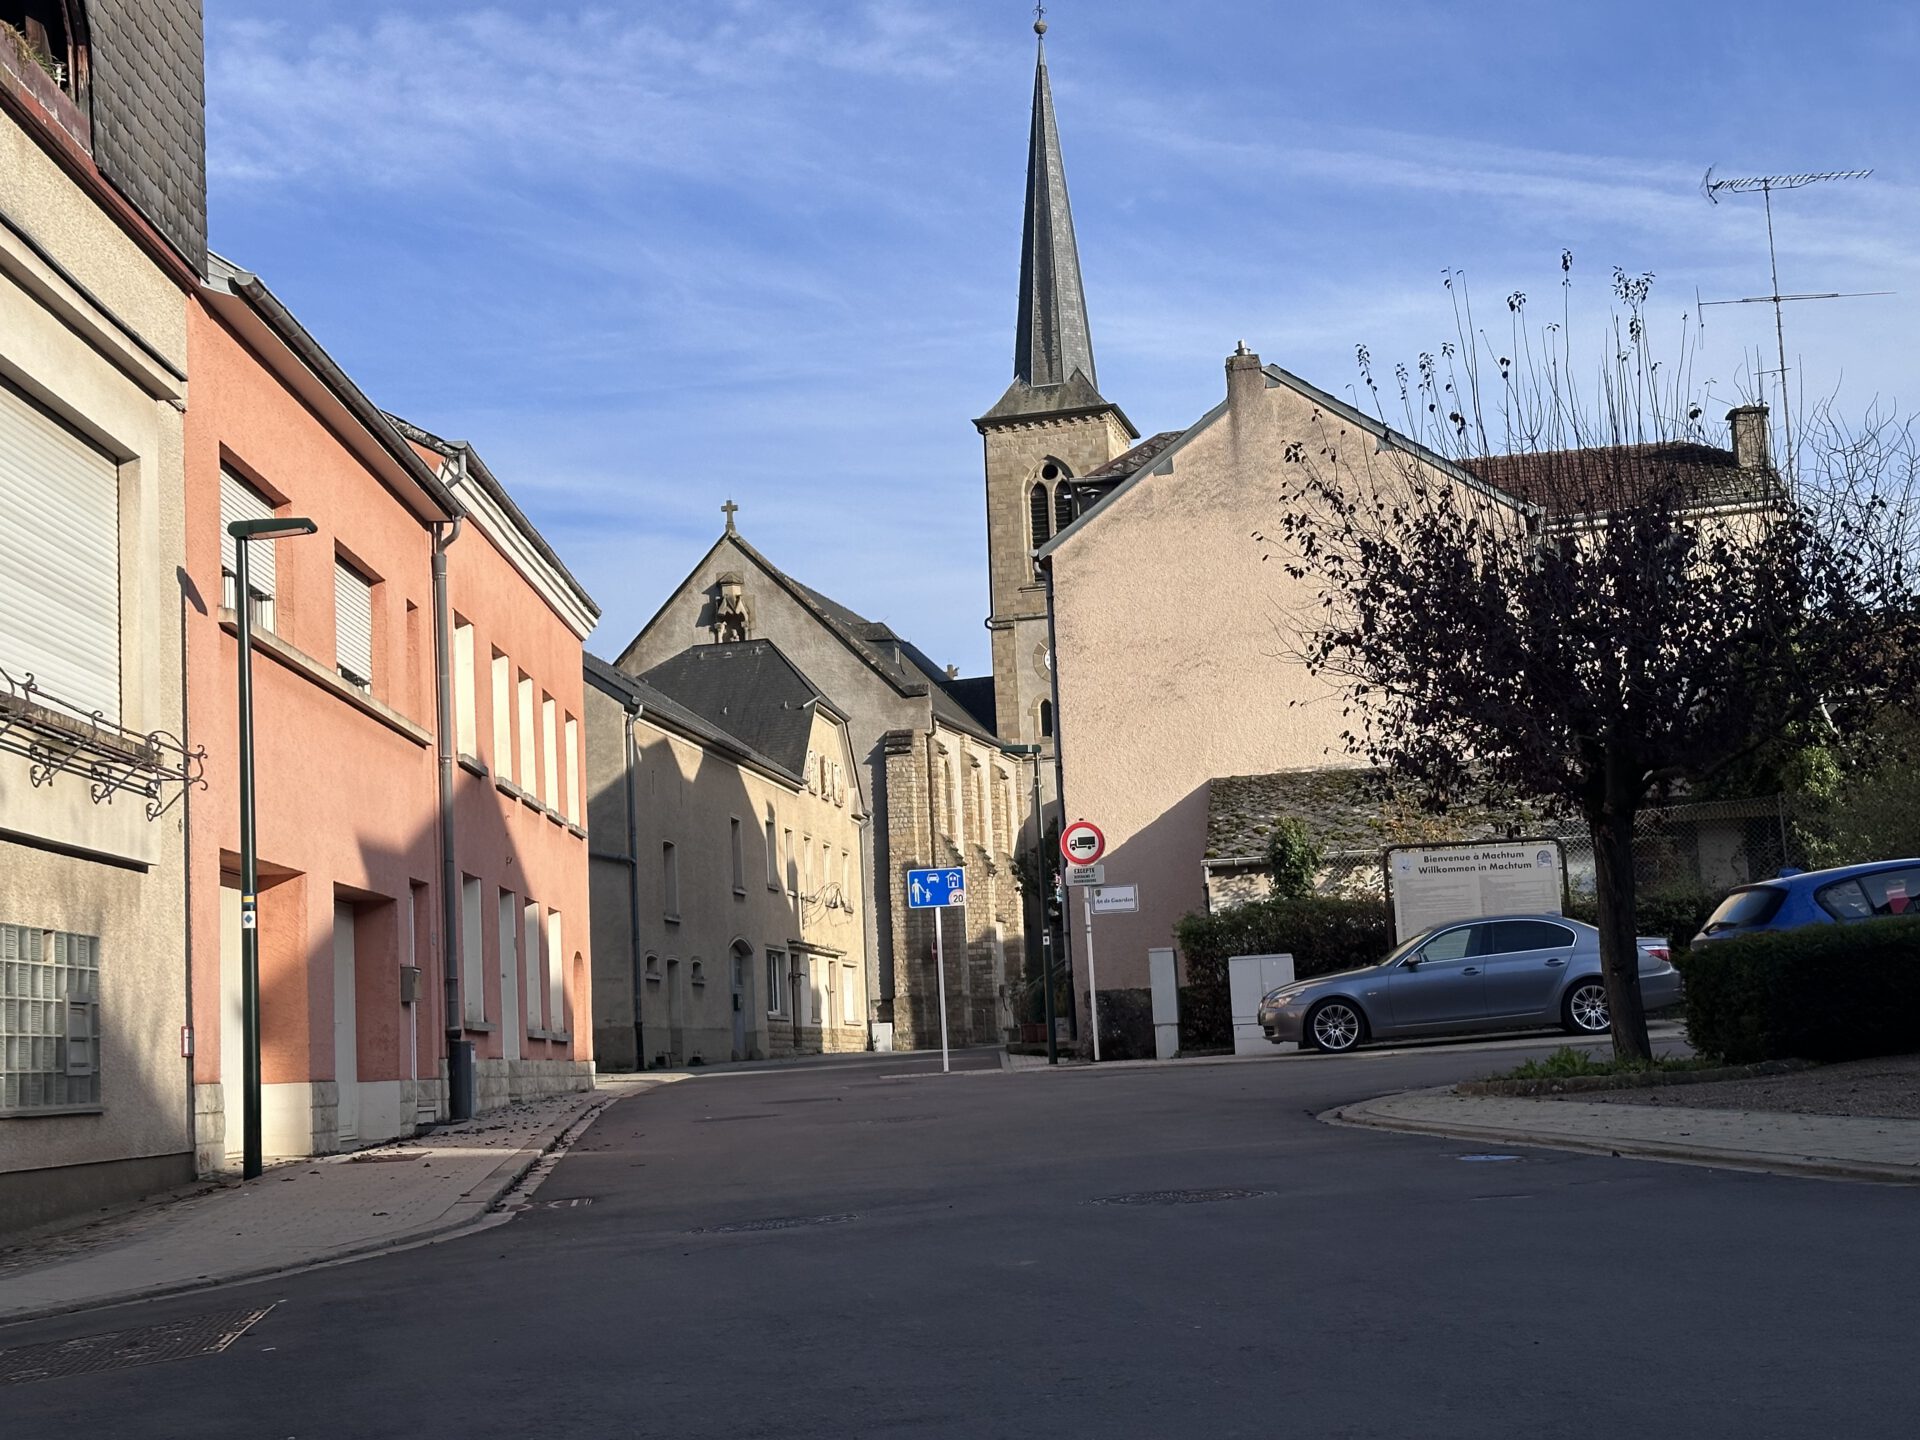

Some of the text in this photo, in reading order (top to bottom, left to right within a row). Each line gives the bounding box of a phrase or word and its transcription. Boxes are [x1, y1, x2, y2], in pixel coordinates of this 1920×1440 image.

[1423, 855, 1471, 863] Bienvenue
[1481, 850, 1525, 860] Machtum
[1418, 861, 1532, 874] Willkommen in Machtum
[953, 894, 964, 903] 20
